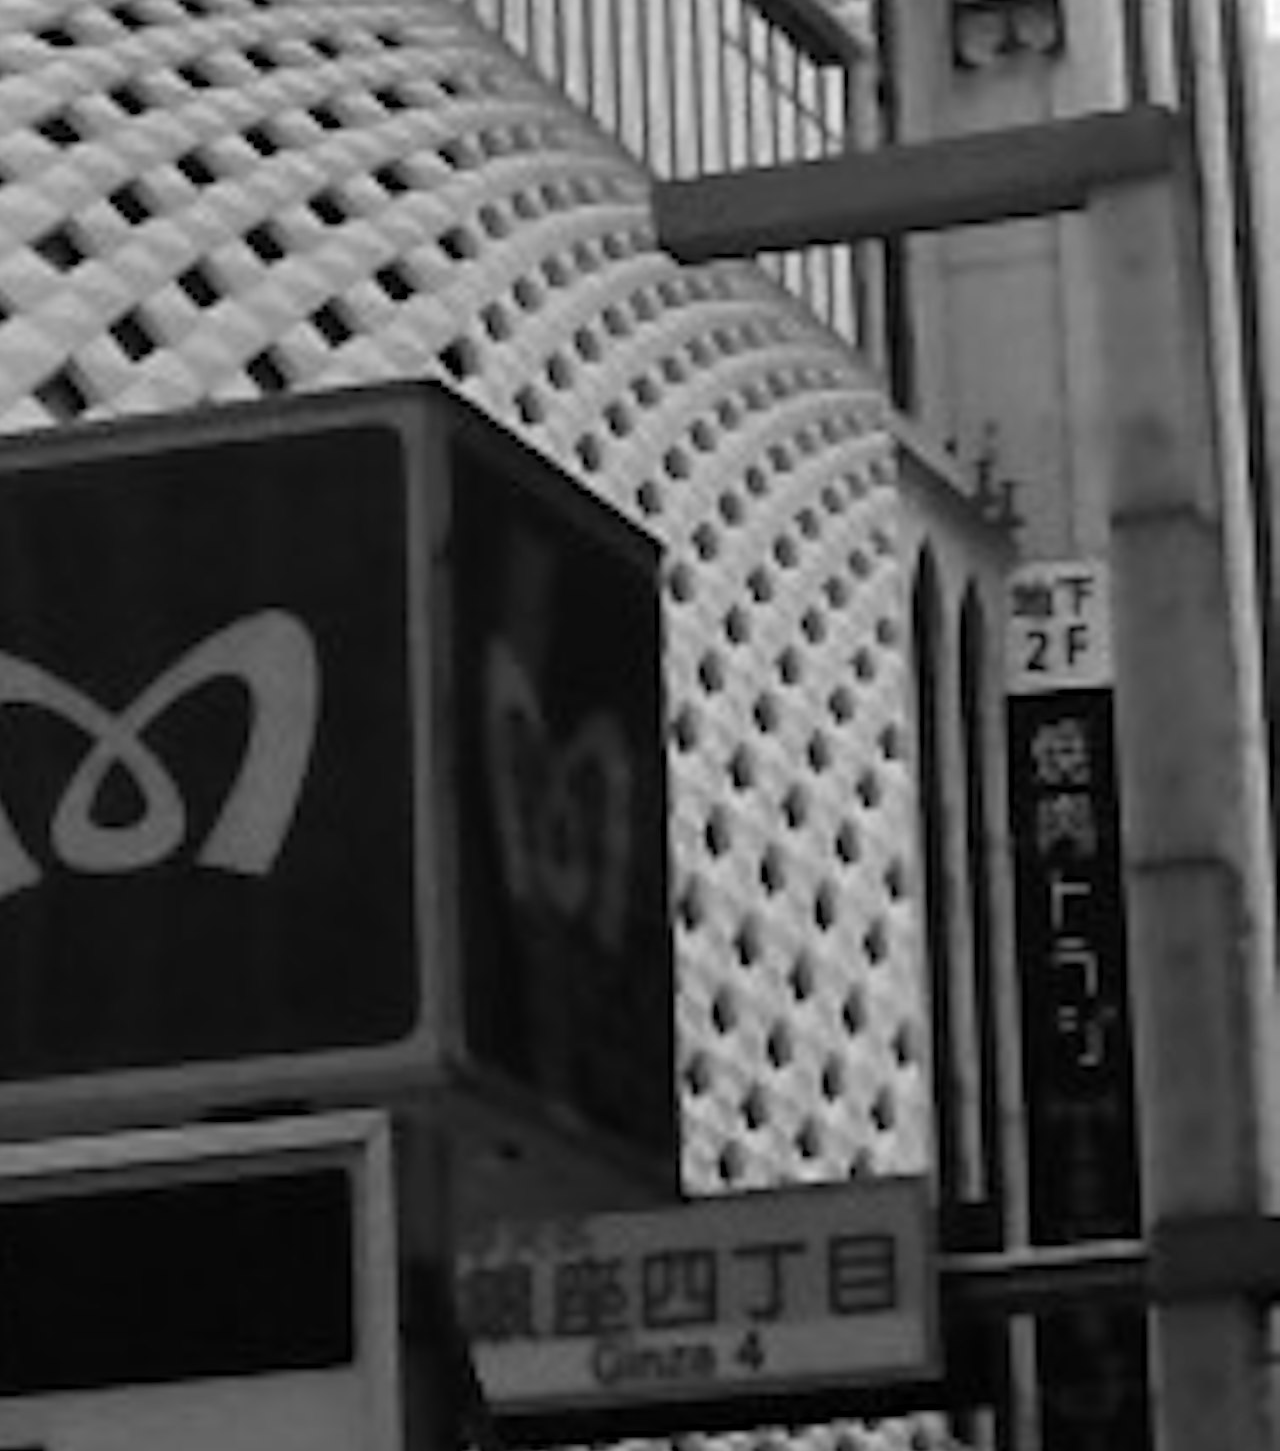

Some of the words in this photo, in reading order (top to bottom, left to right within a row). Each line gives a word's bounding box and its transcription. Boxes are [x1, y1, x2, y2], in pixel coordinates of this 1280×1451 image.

[1026, 625, 1088, 671] 2F
[460, 1234, 896, 1338] 銀座四丁目
[593, 1342, 717, 1385] Ginza
[735, 1331, 766, 1372] 4
